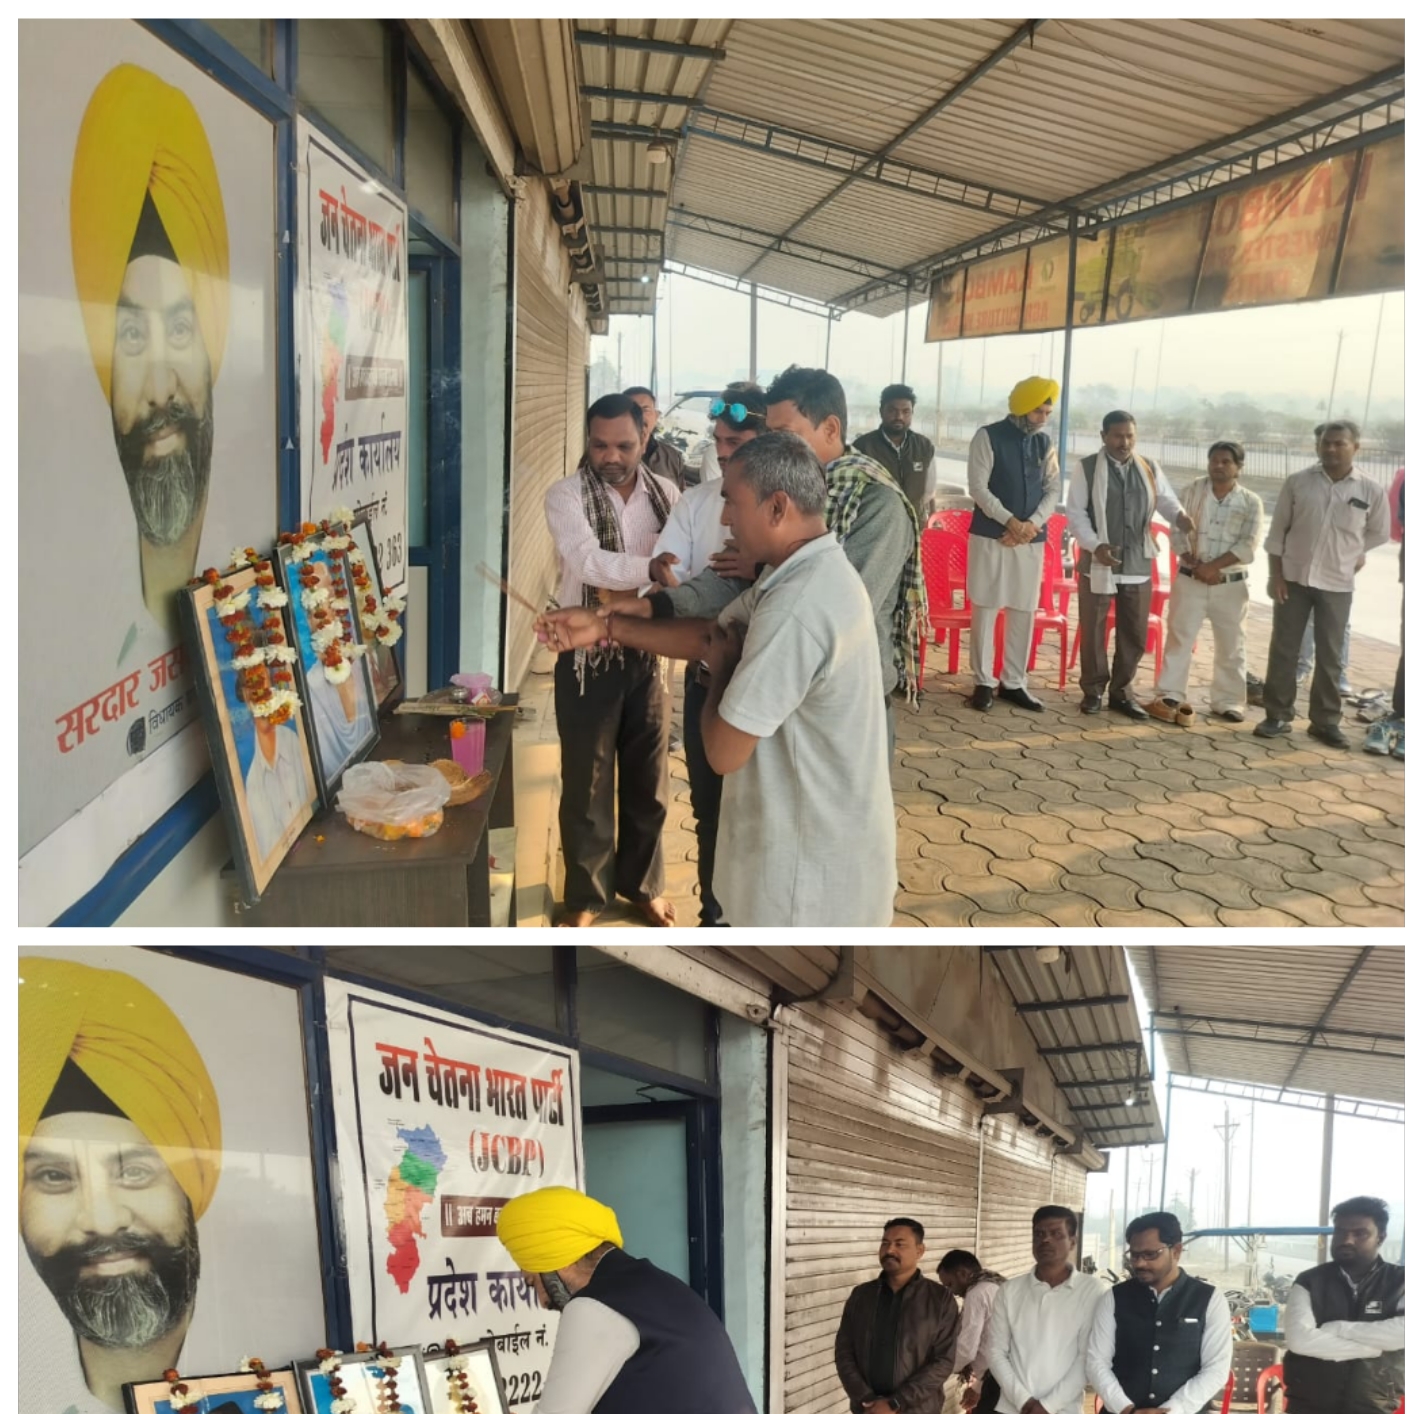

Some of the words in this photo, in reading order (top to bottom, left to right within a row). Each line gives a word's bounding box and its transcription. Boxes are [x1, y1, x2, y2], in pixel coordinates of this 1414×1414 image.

[318, 188, 339, 255] जन
[358, 411, 401, 481] कार्यालय
[386, 532, 402, 571] 363
[55, 669, 141, 754] सरदार
[148, 694, 183, 735] विधायक
[376, 1042, 419, 1102] जन
[424, 1036, 481, 1112] चेतना
[485, 1067, 527, 1120] भारत
[531, 1069, 564, 1126] पार्टी
[469, 1129, 545, 1178] (JCBP)
[457, 1205, 472, 1226] अब
[475, 1205, 492, 1225] हमन
[427, 1257, 478, 1320] प्रदेश
[535, 1323, 549, 1347] नं.
[502, 1370, 542, 1406] 222
